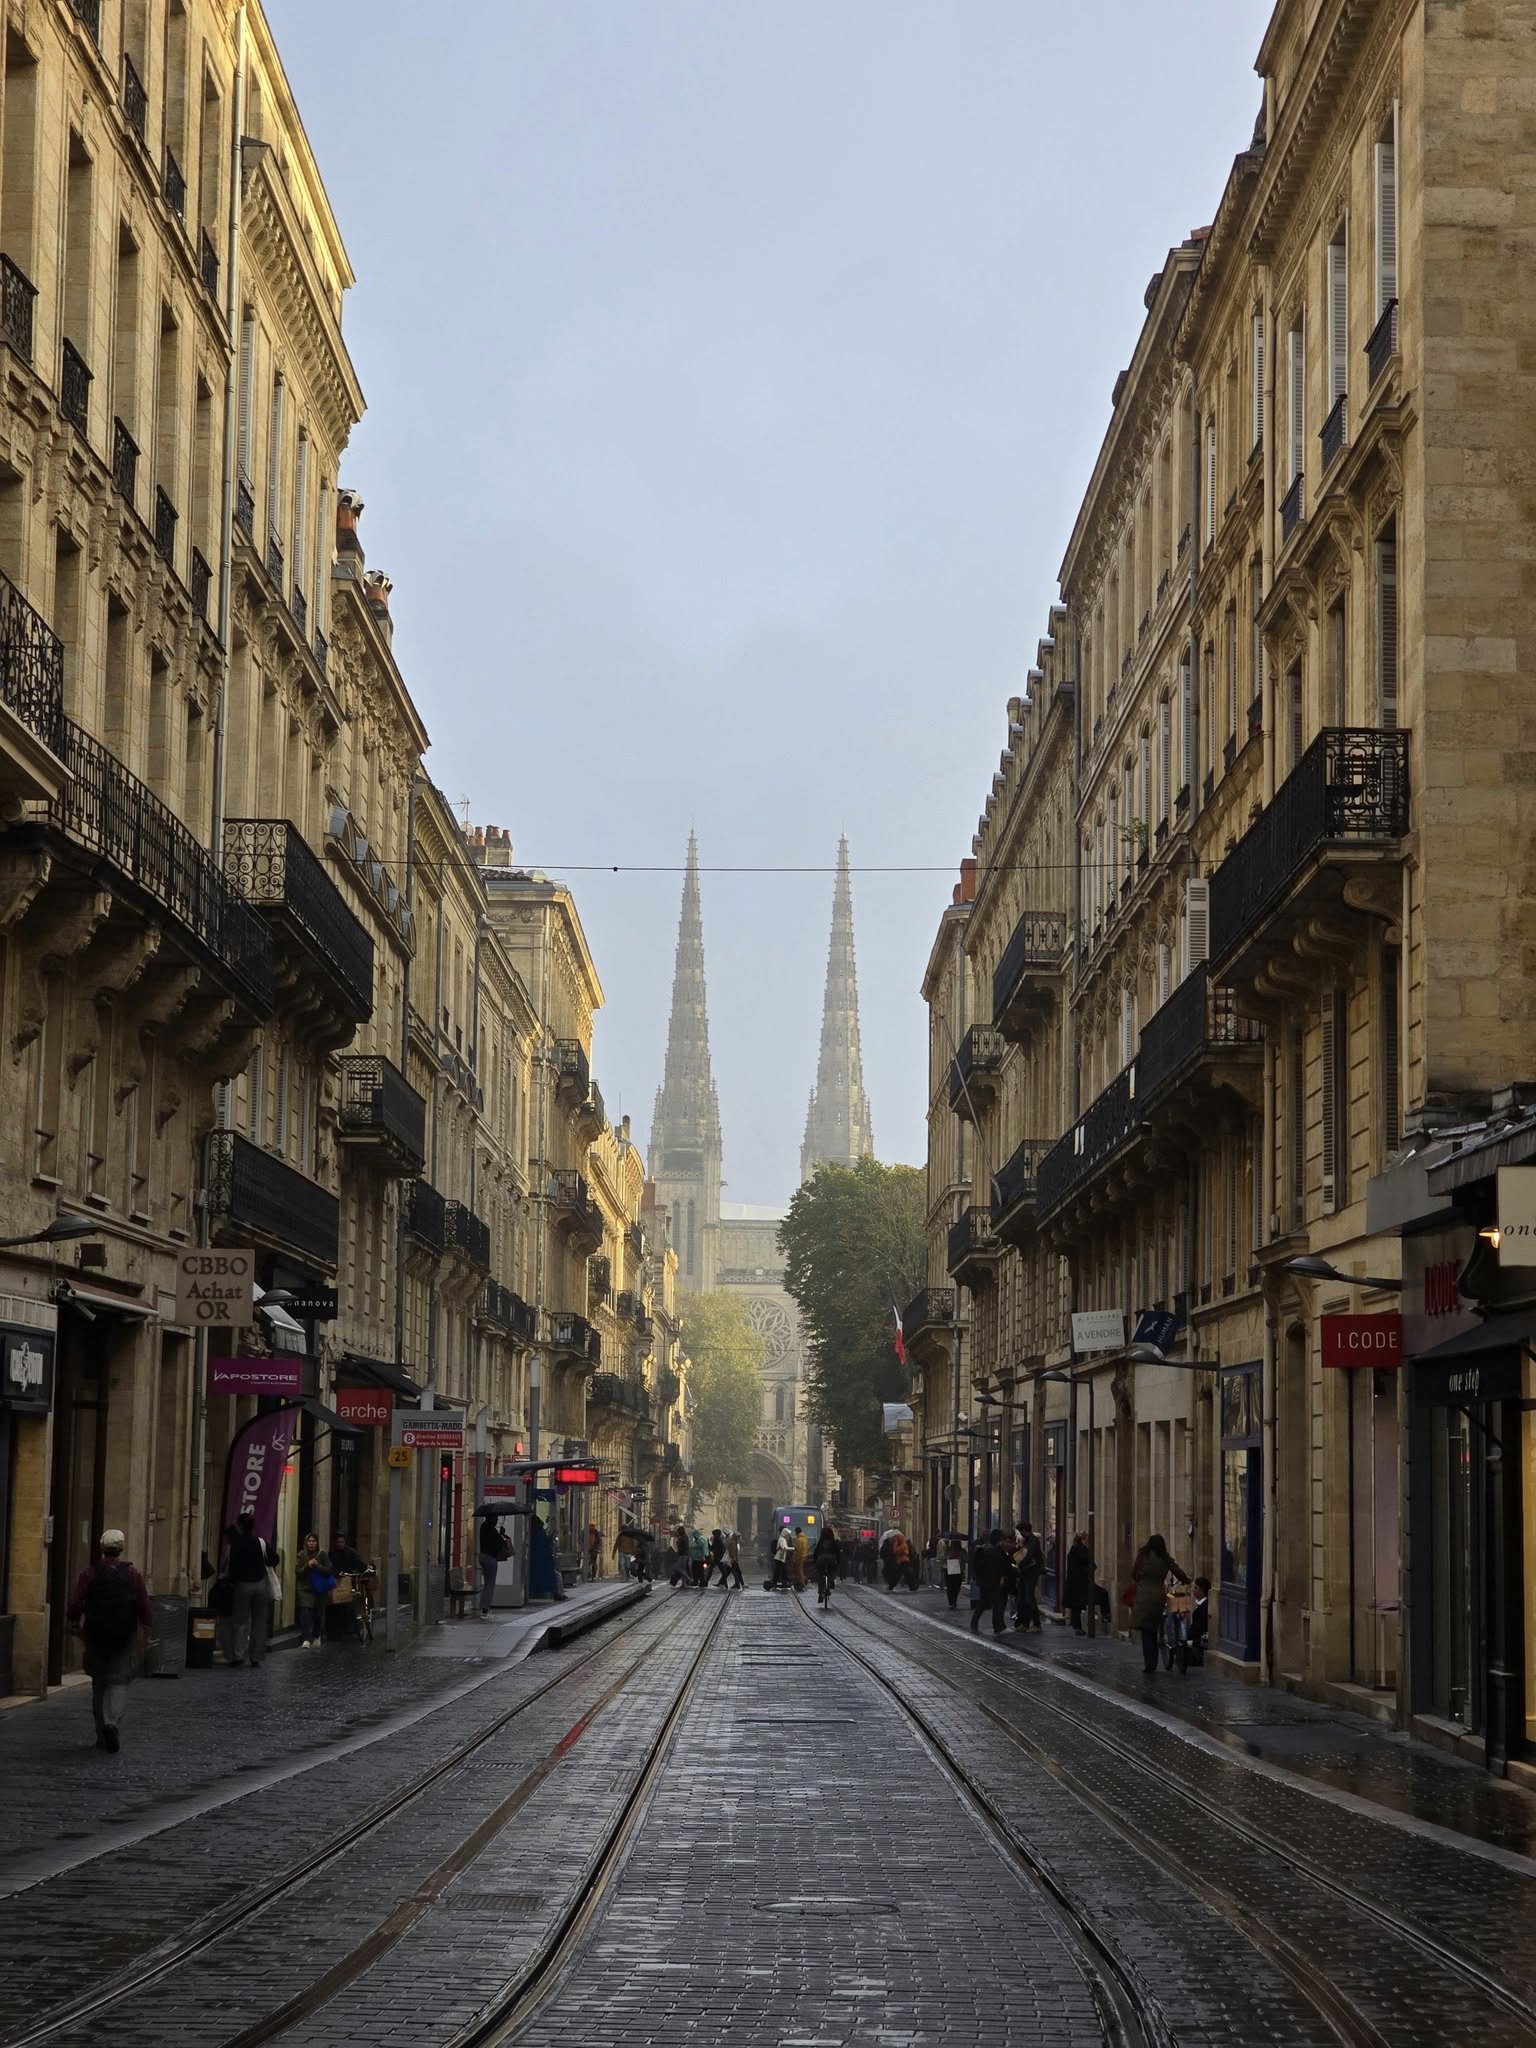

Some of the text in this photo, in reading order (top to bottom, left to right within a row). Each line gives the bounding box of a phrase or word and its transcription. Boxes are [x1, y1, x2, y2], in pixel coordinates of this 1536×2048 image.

[182, 1256, 248, 1275] CBBO
[186, 1280, 243, 1299] Achat
[196, 1301, 231, 1320] OR
[1084, 1328, 1121, 1340] VENDRE
[1338, 1331, 1398, 1349] I.CODE
[213, 1368, 298, 1381] VAPOSTORE
[1449, 1368, 1480, 1396] one step
[340, 1403, 387, 1418] arche
[395, 1450, 408, 1462] 25
